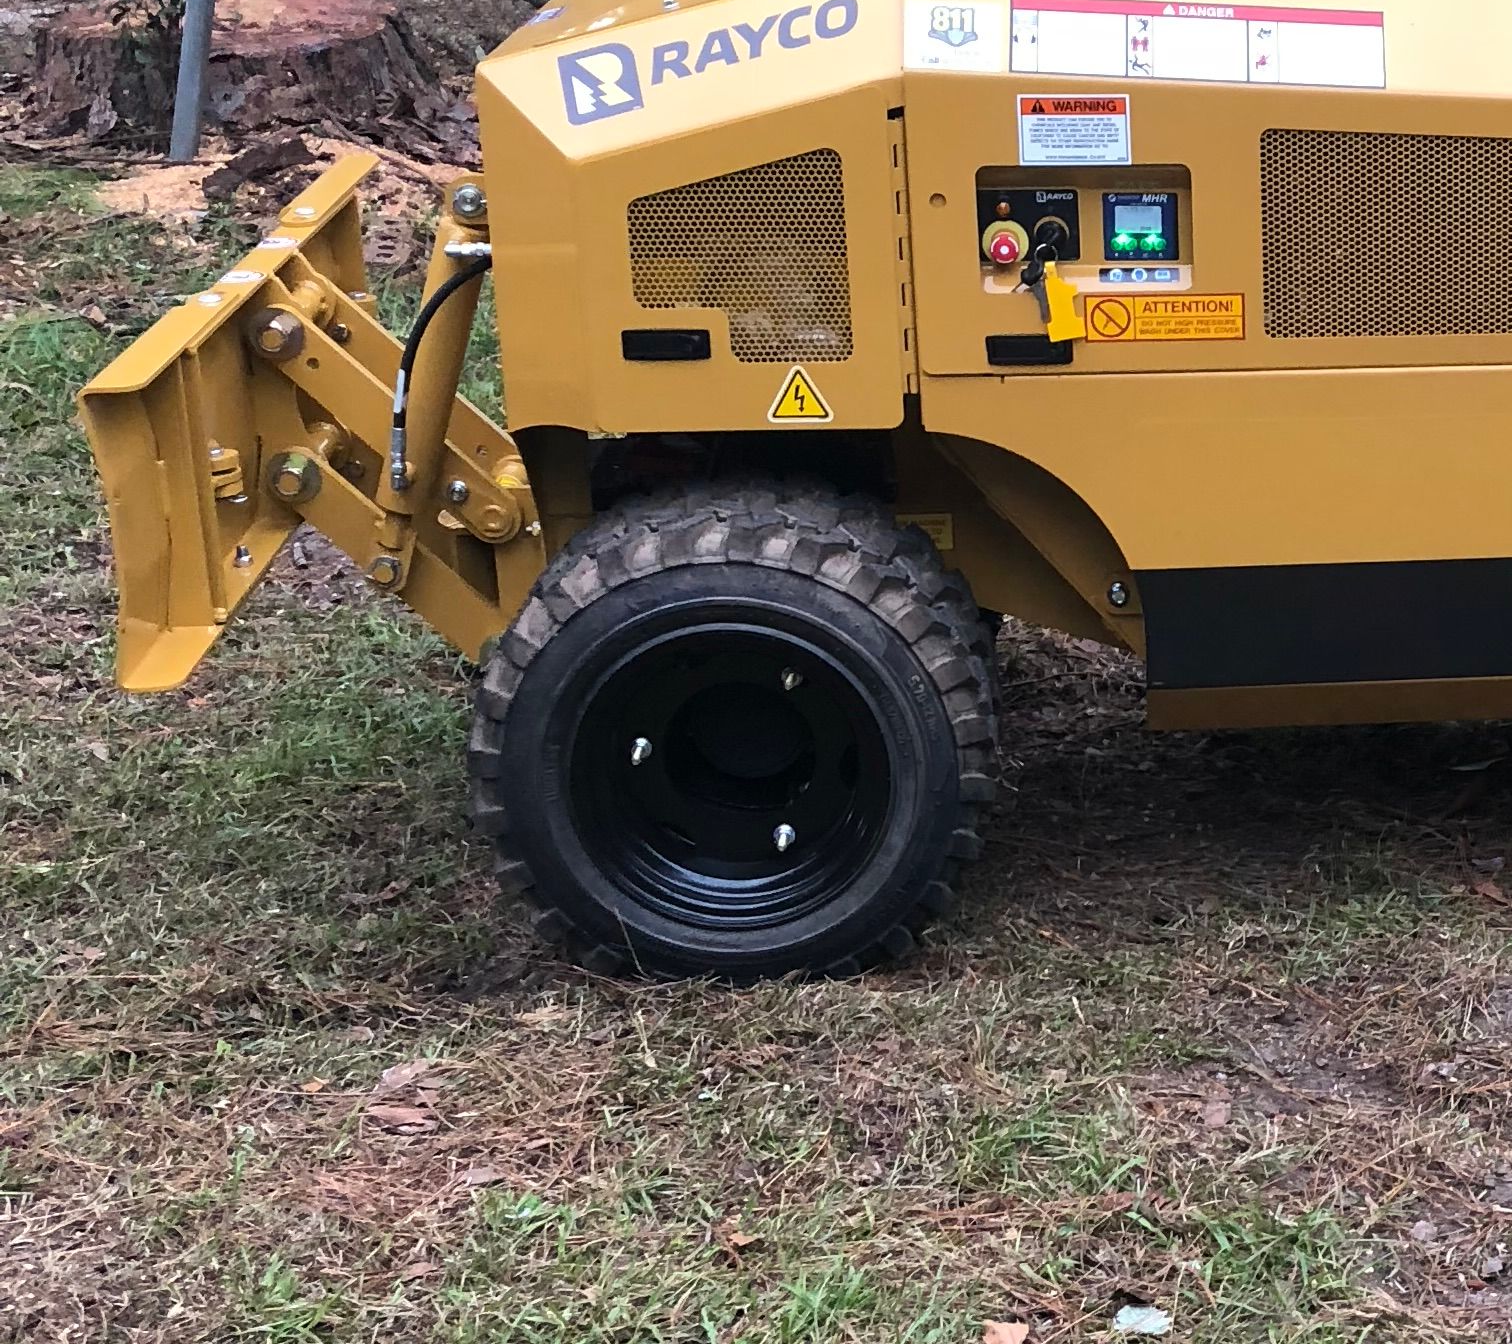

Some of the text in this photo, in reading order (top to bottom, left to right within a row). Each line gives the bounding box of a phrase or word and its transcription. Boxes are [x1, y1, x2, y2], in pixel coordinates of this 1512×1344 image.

[1178, 4, 1235, 18] DANGER
[930, 5, 976, 34] 811
[1052, 100, 1117, 112] WARNING
[1141, 194, 1168, 203] MHR
[1142, 300, 1233, 314] ATTENTION!
